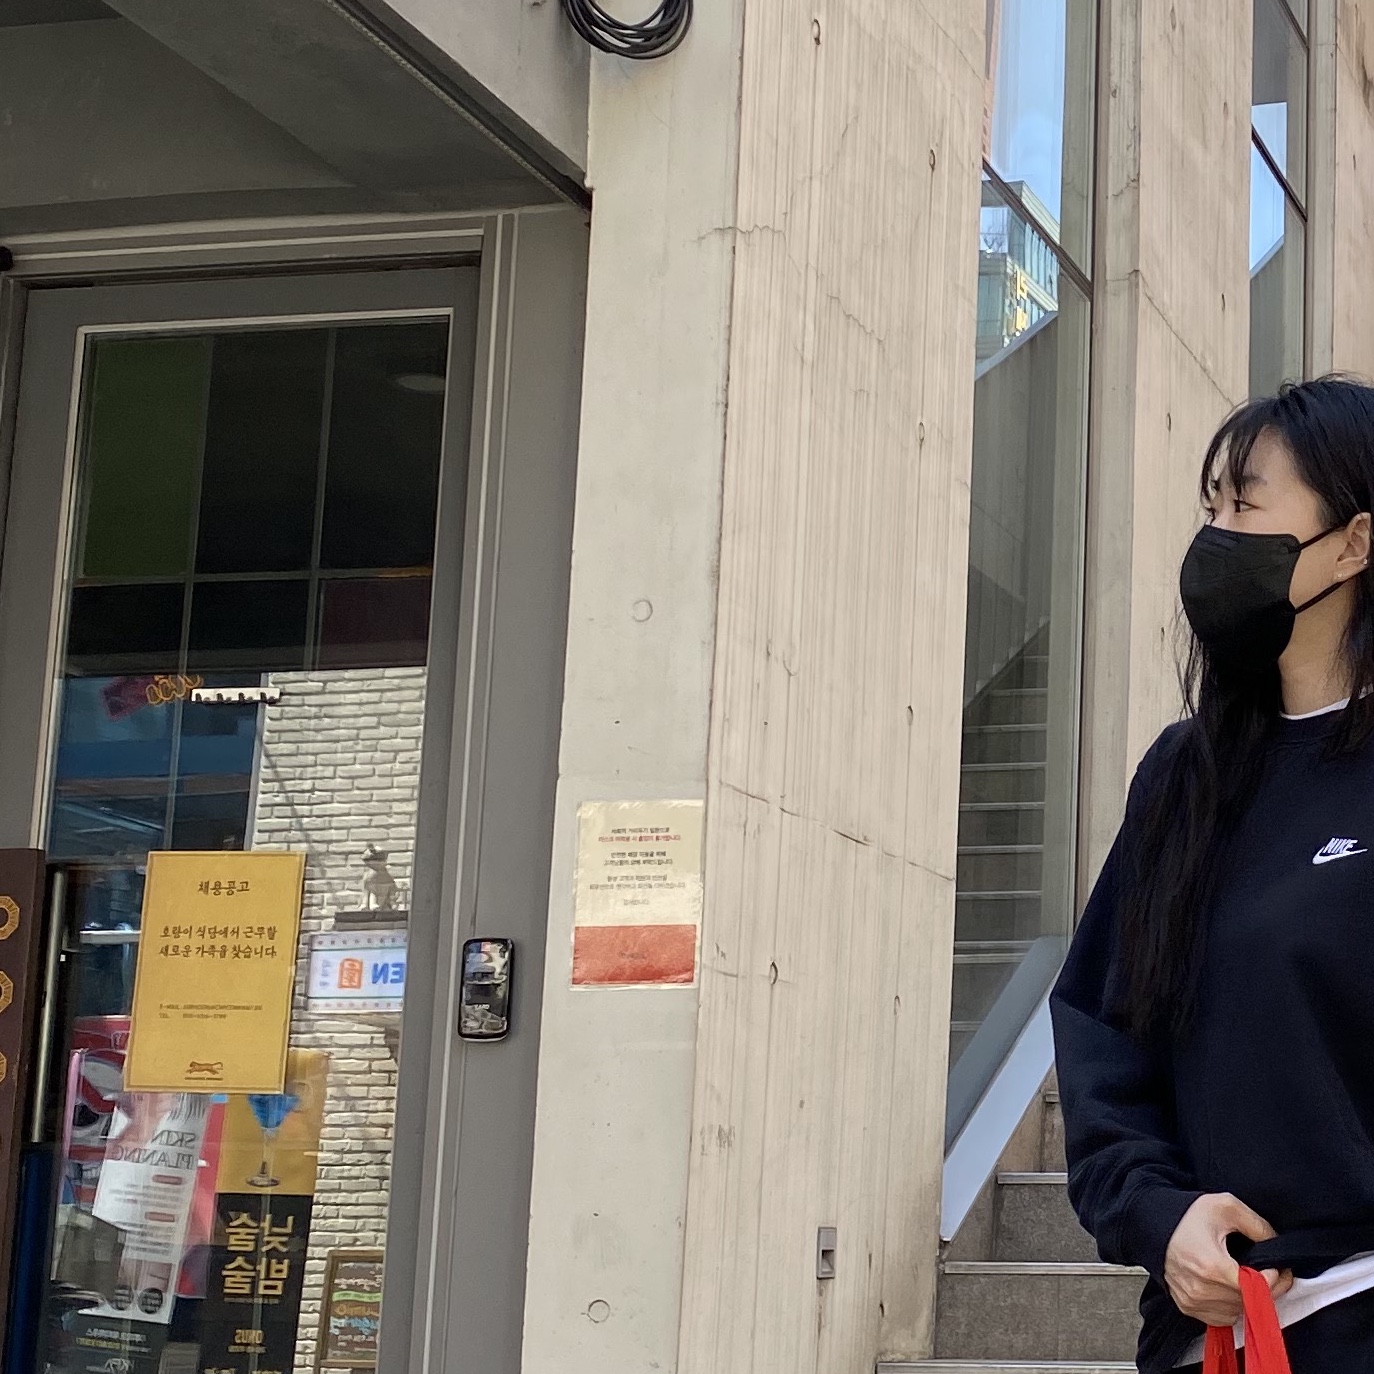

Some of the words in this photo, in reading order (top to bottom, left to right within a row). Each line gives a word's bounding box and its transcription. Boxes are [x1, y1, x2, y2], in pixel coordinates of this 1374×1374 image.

[1319, 836, 1361, 858] NIKE
[197, 880, 250, 896] 채용공고
[159, 925, 193, 940] 호랑이
[195, 925, 240, 940] 식당에서
[243, 925, 277, 941] 근무할
[159, 944, 192, 958] 새로운
[194, 944, 228, 959] 가족을
